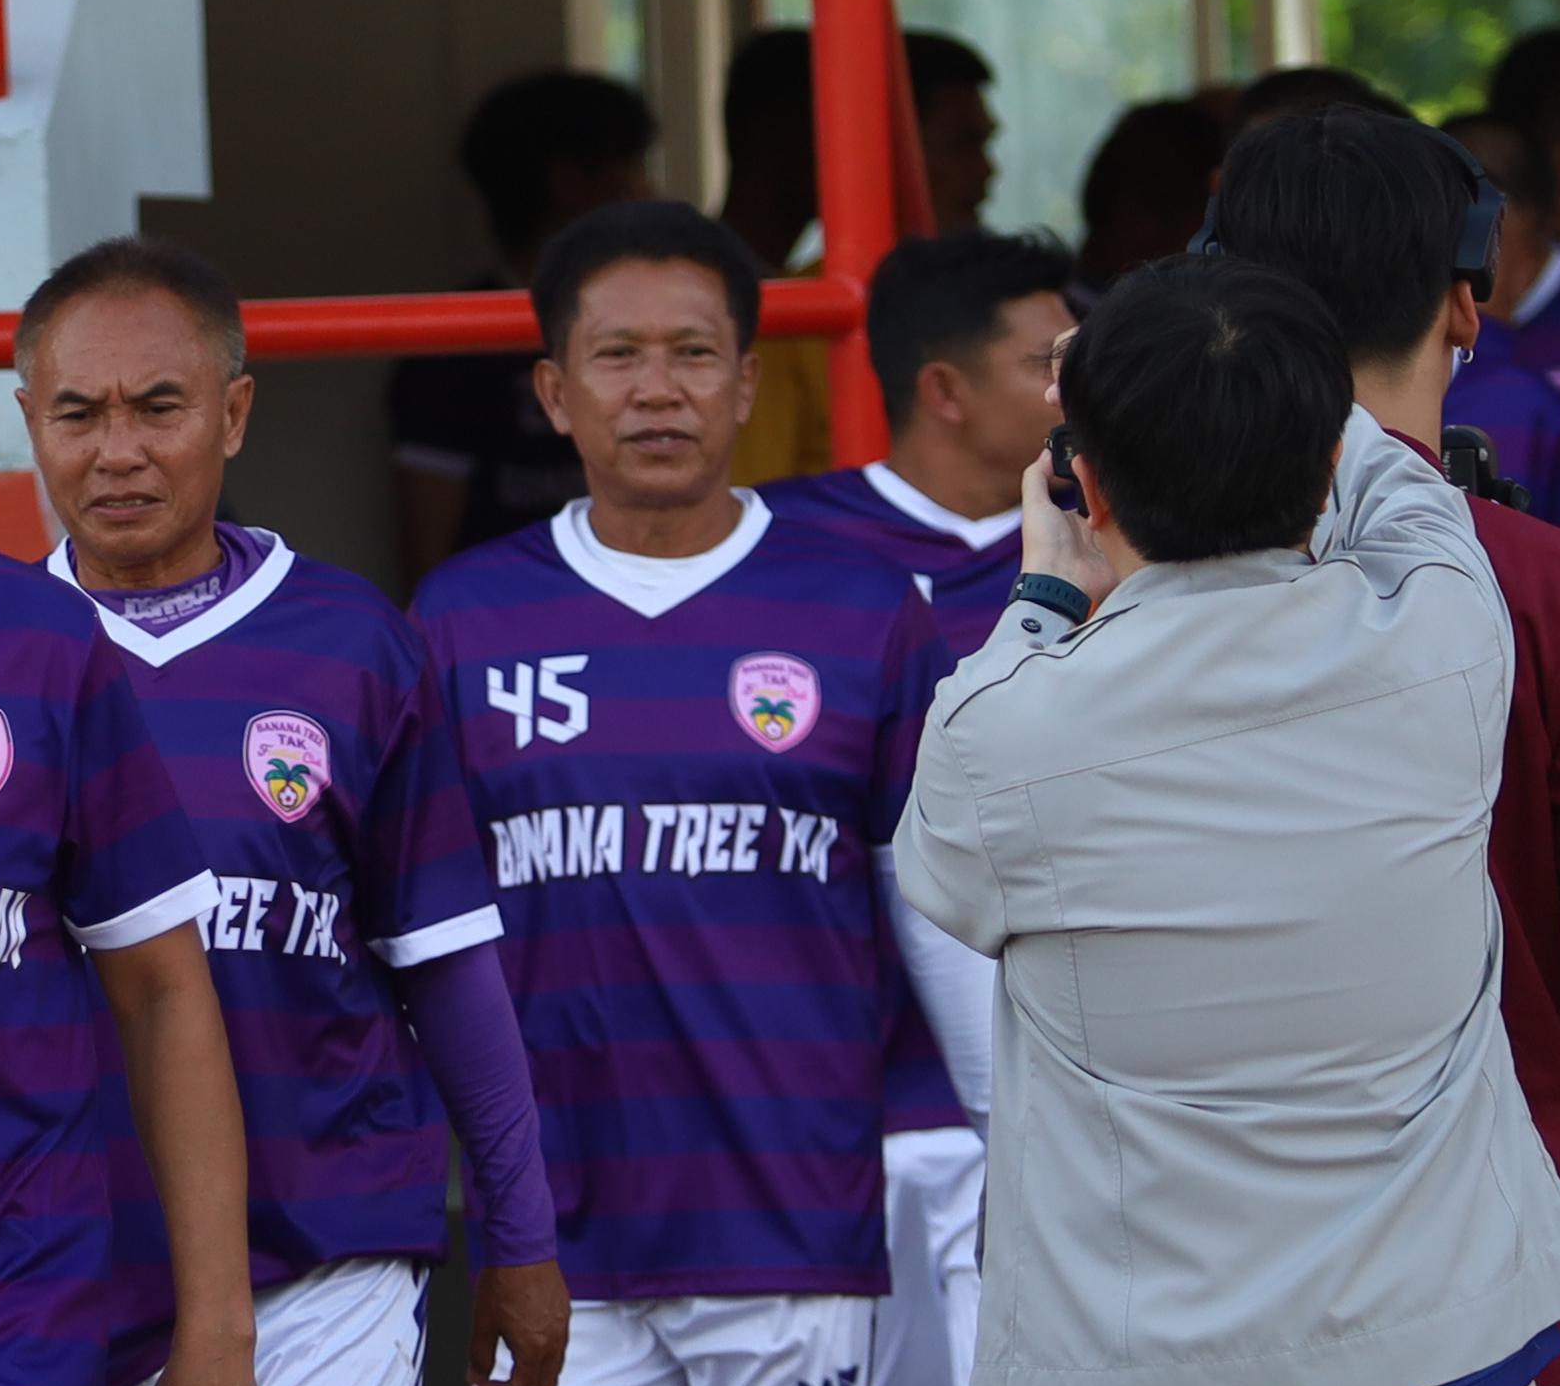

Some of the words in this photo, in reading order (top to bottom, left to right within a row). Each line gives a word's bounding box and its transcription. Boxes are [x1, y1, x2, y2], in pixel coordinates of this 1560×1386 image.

[486, 654, 590, 750] 45
[278, 733, 307, 750] TAK
[641, 803, 767, 879] TREE
